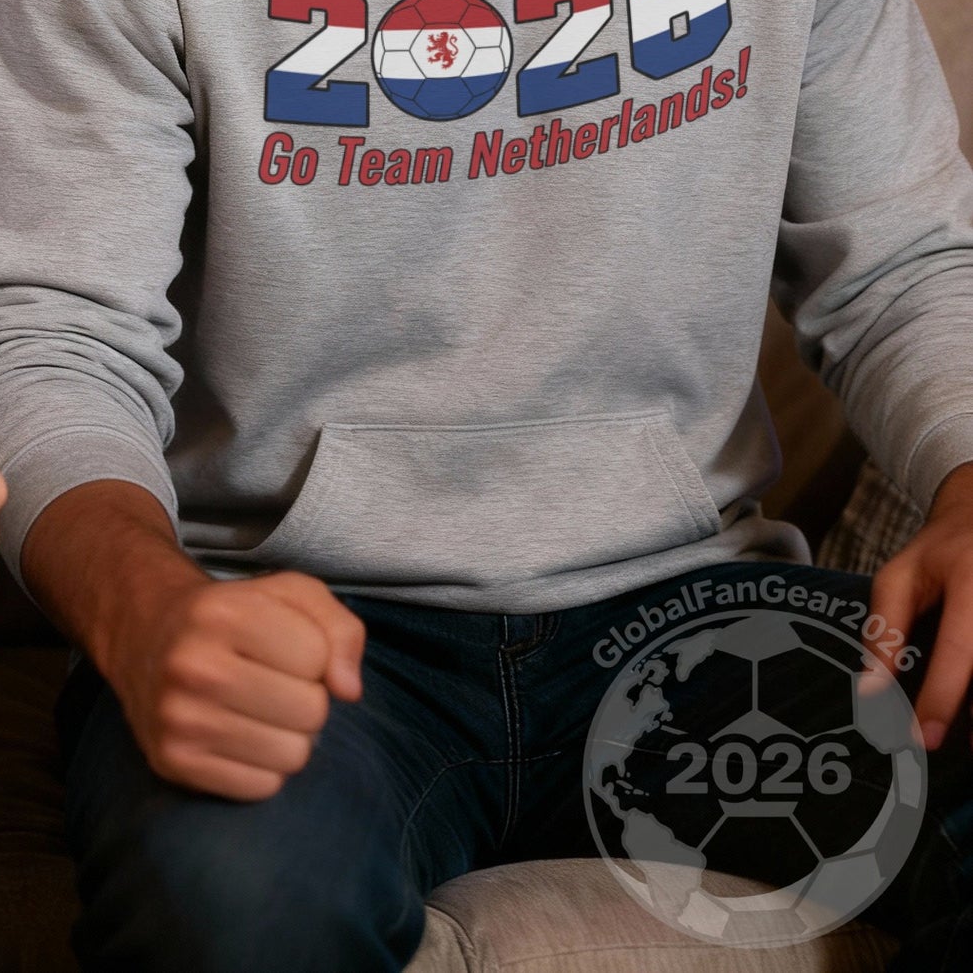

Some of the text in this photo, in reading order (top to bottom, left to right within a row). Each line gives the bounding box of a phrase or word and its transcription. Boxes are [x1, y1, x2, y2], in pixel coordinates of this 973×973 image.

[258, 46, 752, 187] Go Team Netherlands!
